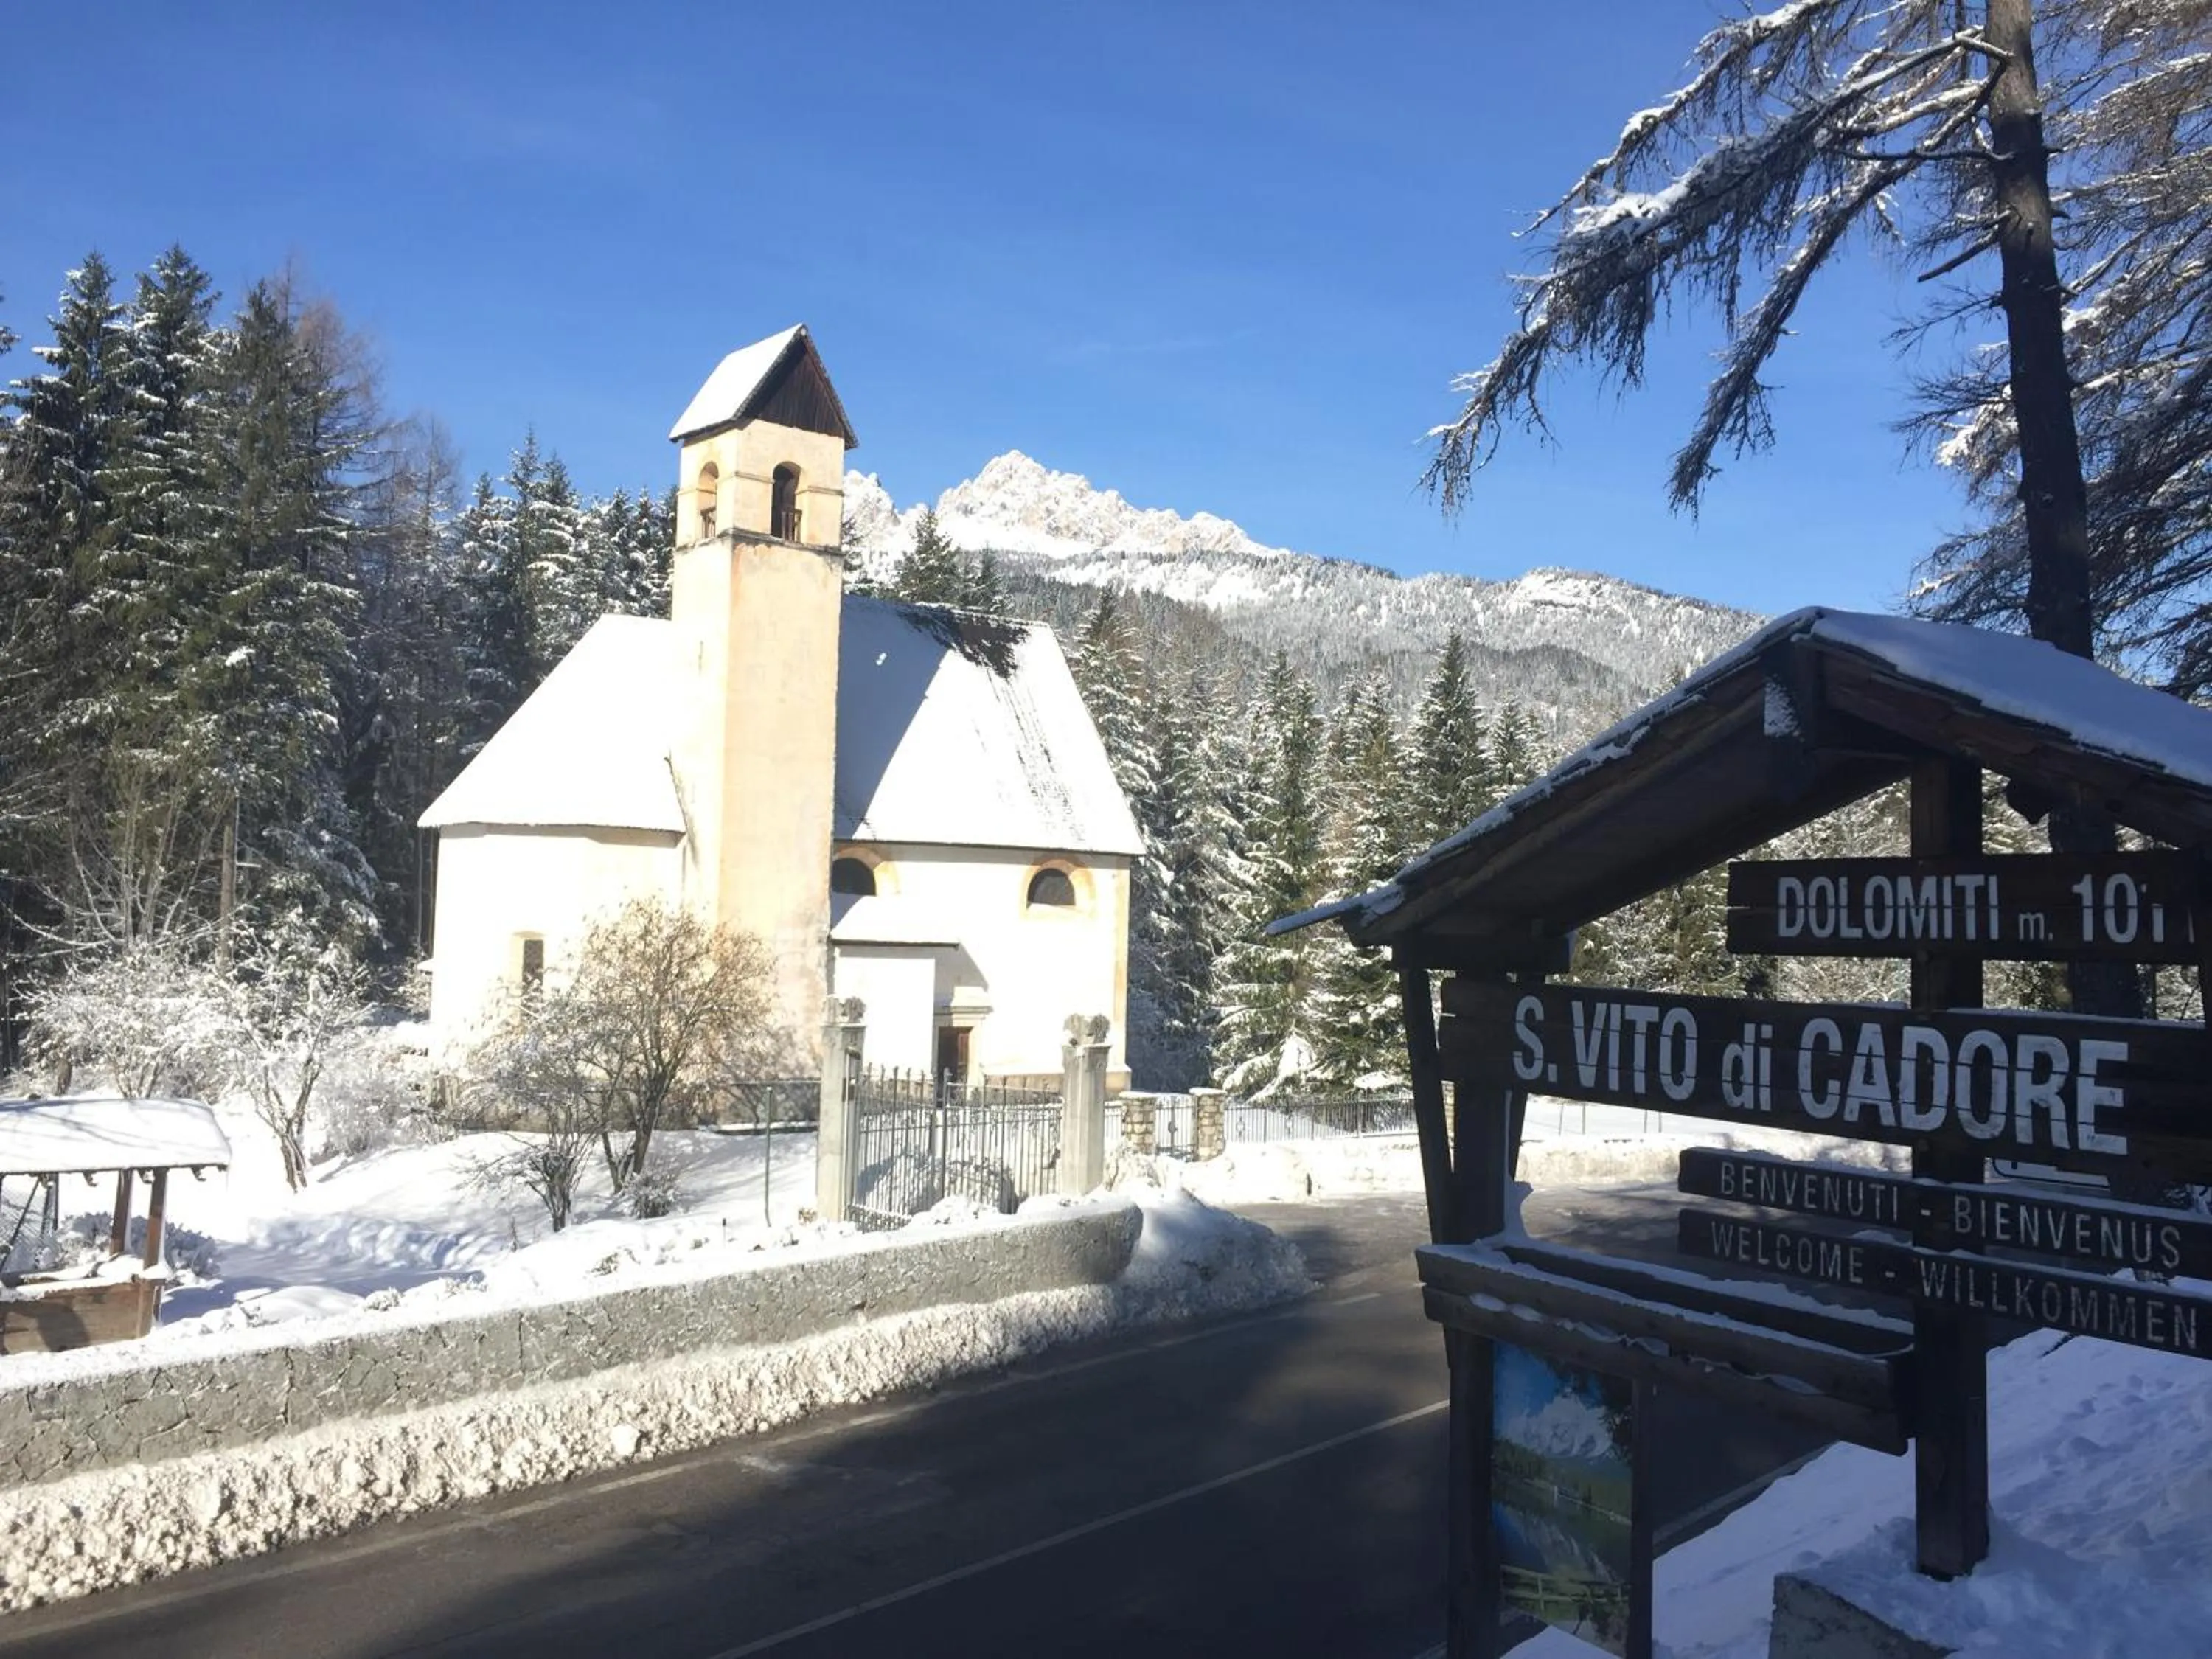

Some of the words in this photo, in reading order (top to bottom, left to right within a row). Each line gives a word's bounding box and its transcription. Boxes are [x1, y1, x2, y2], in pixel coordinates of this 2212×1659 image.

[1778, 874, 1998, 941] DOLOMITI
[2018, 910, 2053, 941] m.
[1513, 996, 1556, 1082] S.
[1572, 1000, 1697, 1101] VITO
[1722, 1022, 1771, 1111] di
[1798, 1018, 2129, 1156] CADORE
[1720, 1163, 1899, 1222] BENVENUTI
[1955, 1195, 2182, 1269] BIENVENUS
[1711, 1220, 1863, 1284] WELCOME
[1920, 1259, 2197, 1349] WILLKOMMEN
